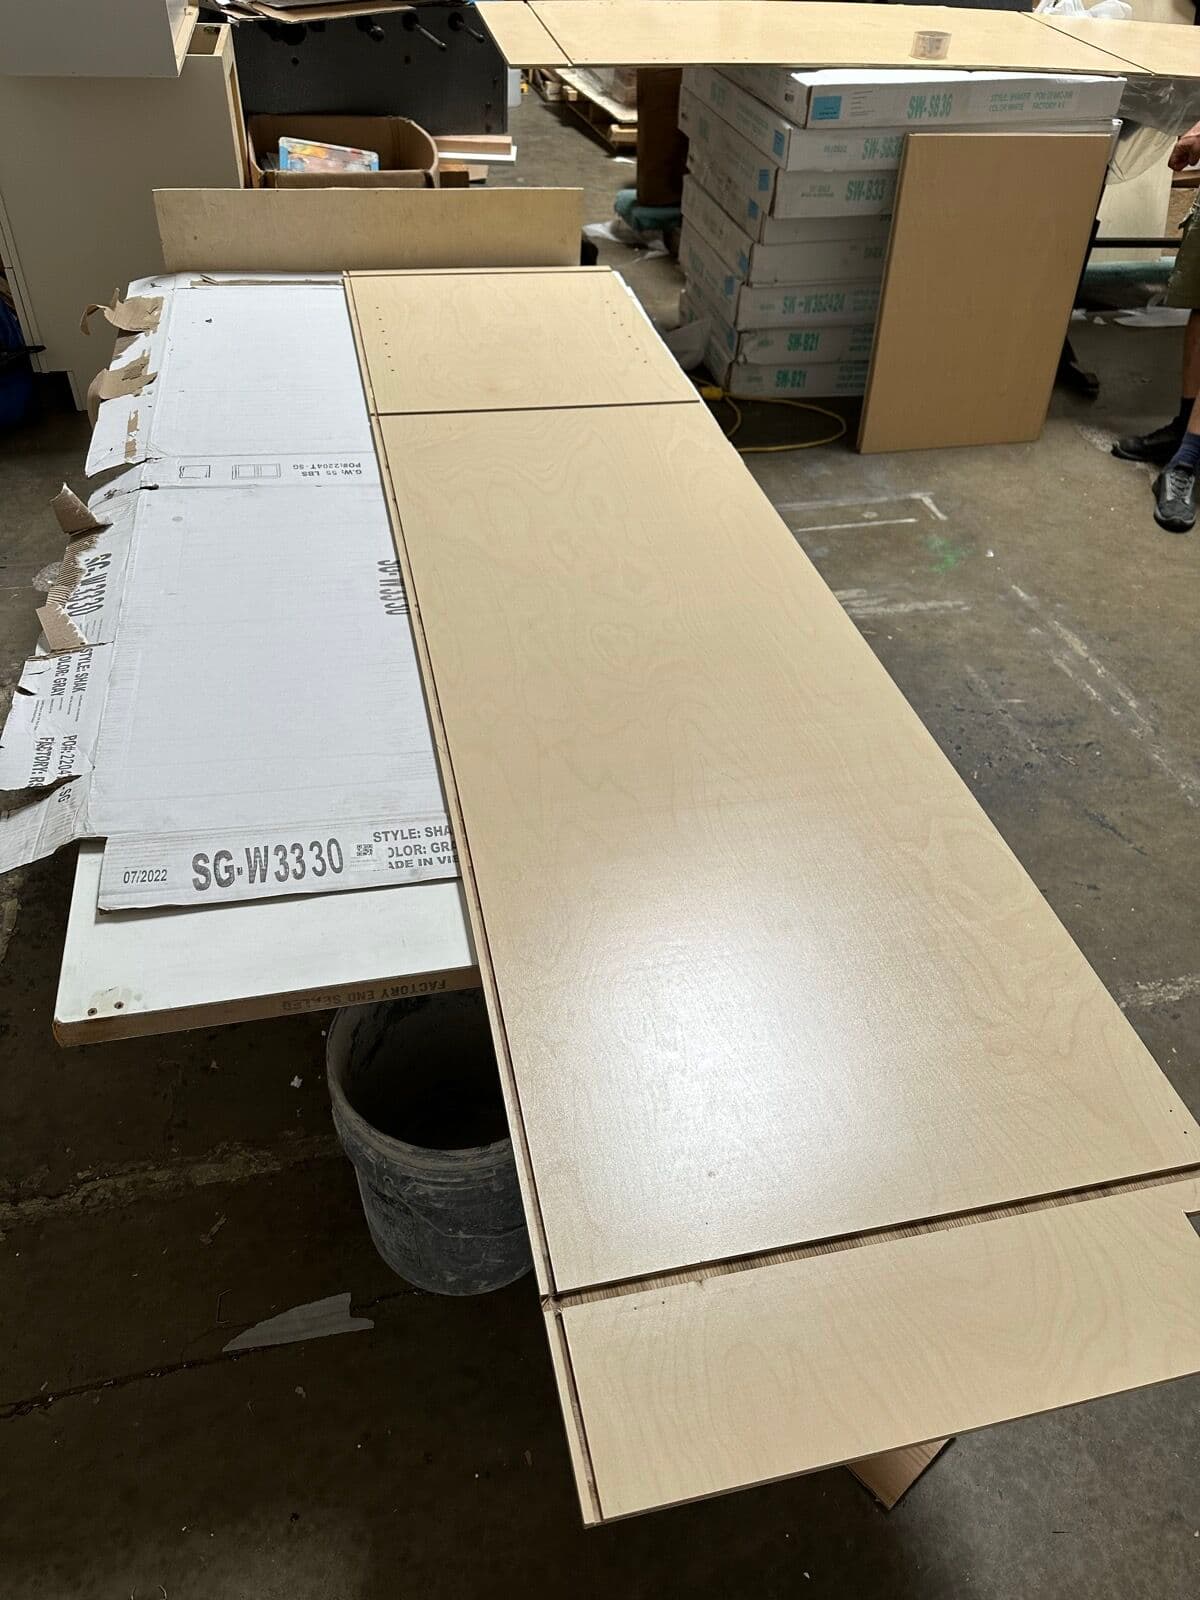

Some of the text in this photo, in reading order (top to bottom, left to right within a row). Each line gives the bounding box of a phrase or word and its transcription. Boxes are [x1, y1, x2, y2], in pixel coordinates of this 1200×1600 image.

[51, 677, 68, 697] GRAY
[373, 828, 421, 843] STYLE:
[192, 838, 344, 892] SG-W3330
[418, 857, 433, 867] IN
[123, 869, 168, 884] 07/2022
[381, 979, 447, 997] FACTORY
[348, 990, 375, 1002] END
